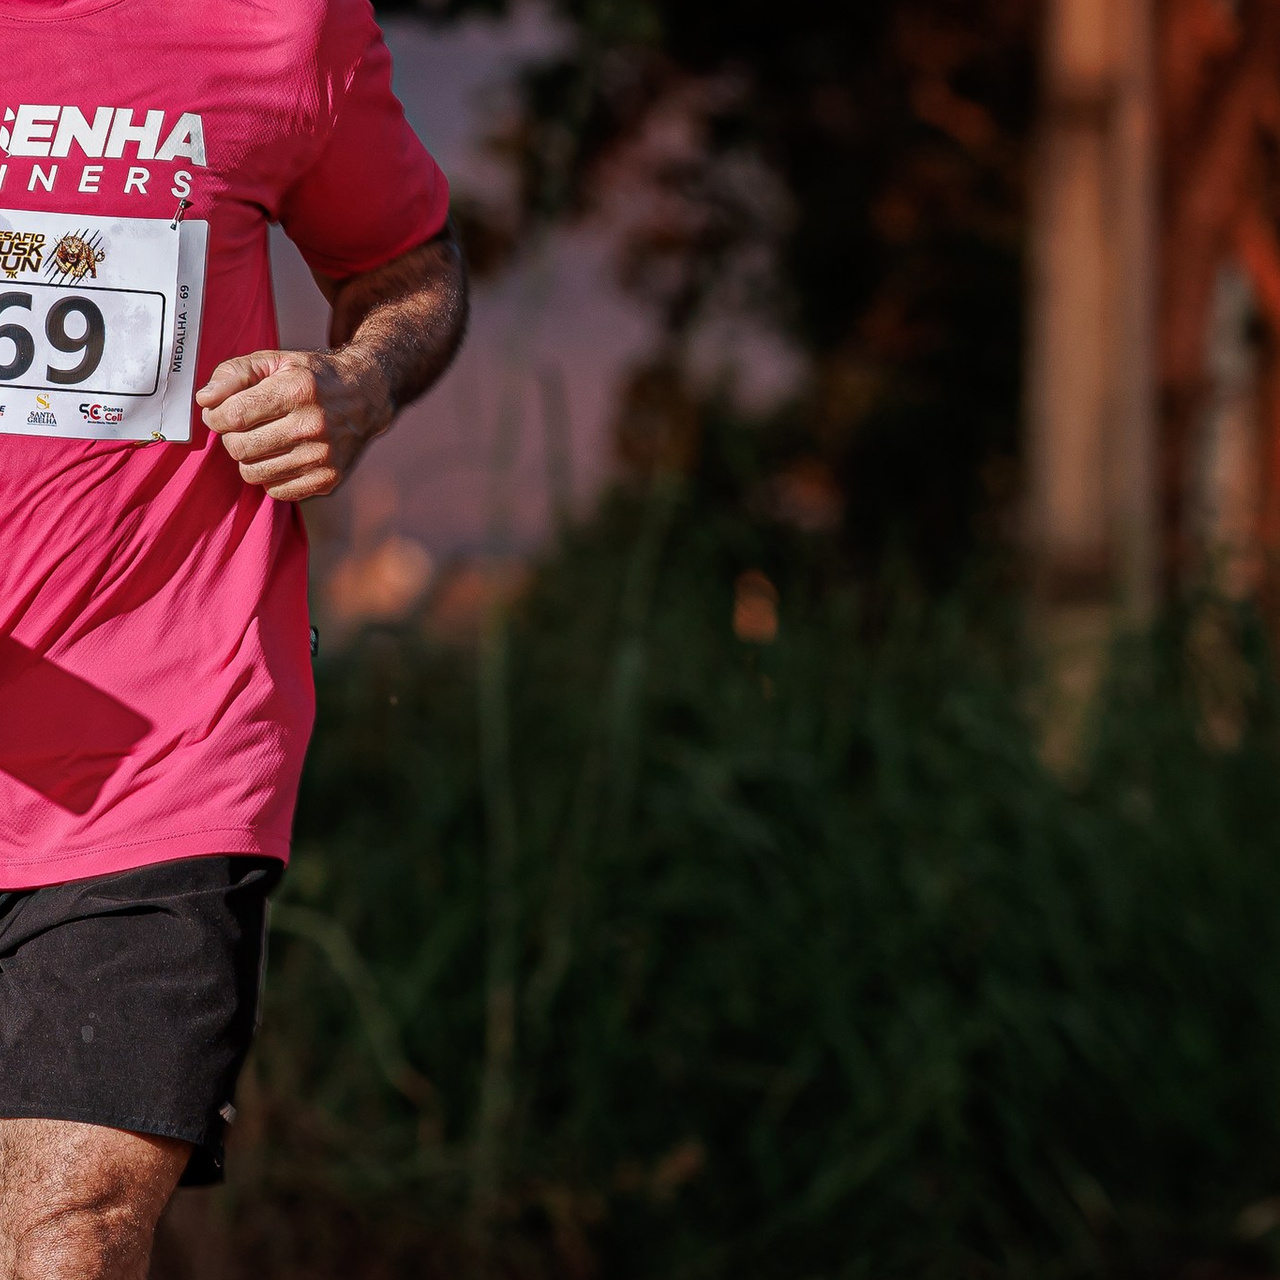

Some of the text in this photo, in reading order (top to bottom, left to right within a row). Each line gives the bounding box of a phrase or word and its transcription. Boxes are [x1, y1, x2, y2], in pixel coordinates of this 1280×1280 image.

[179, 285, 189, 299] 69
[172, 311, 187, 372] MEDALHA
[30, 411, 54, 419] SANTA
[104, 413, 122, 421] Cell
[27, 417, 57, 425] GRELHA
